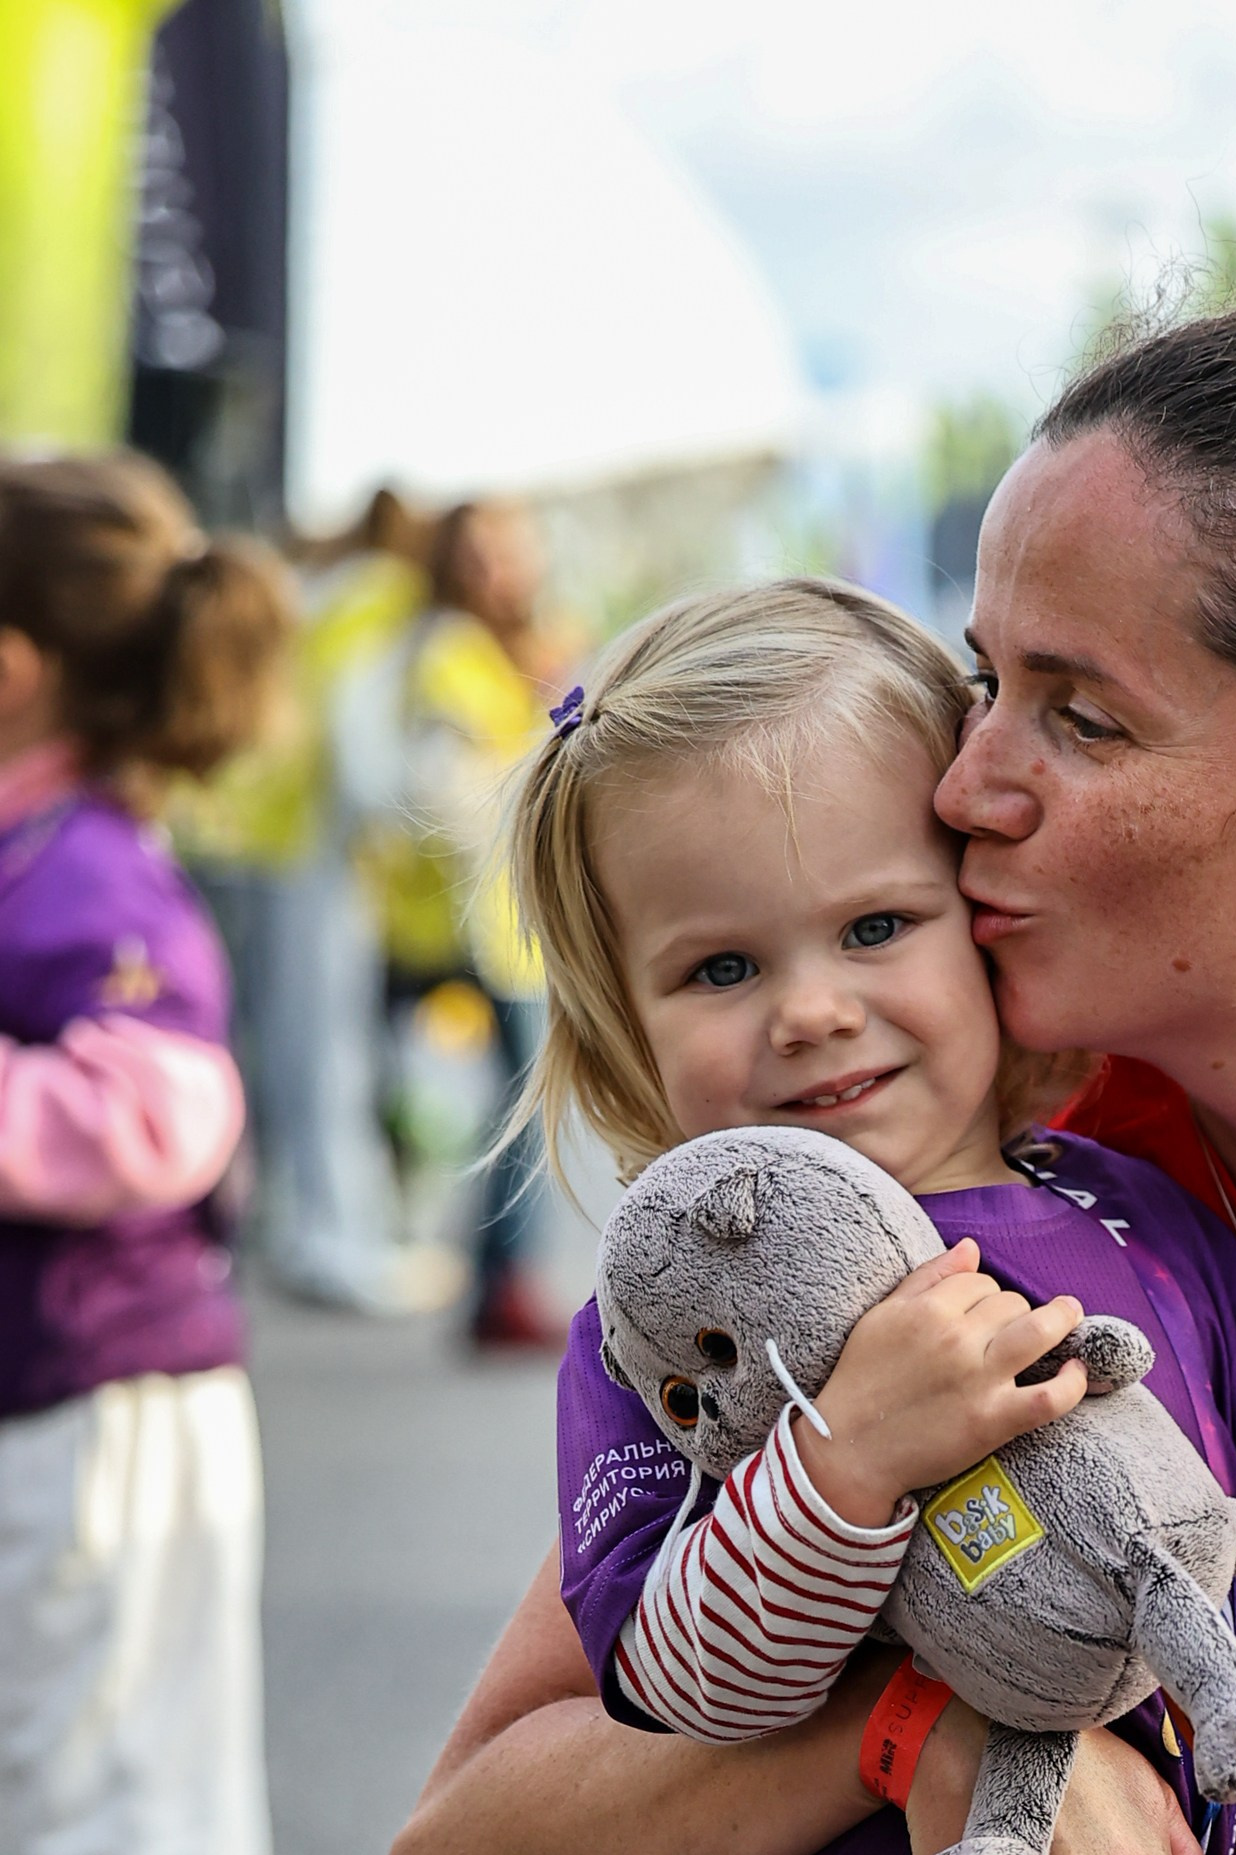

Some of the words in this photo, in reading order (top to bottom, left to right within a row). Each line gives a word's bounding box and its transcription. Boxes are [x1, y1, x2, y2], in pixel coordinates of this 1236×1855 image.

[573, 1439, 678, 1512] ФДЕРАЛЬН
[574, 1460, 686, 1534] ТЕРРИТОРИЯ
[577, 1487, 656, 1554] «СИРИУС
[934, 1485, 1010, 1545] basik
[960, 1513, 1017, 1565] baby
